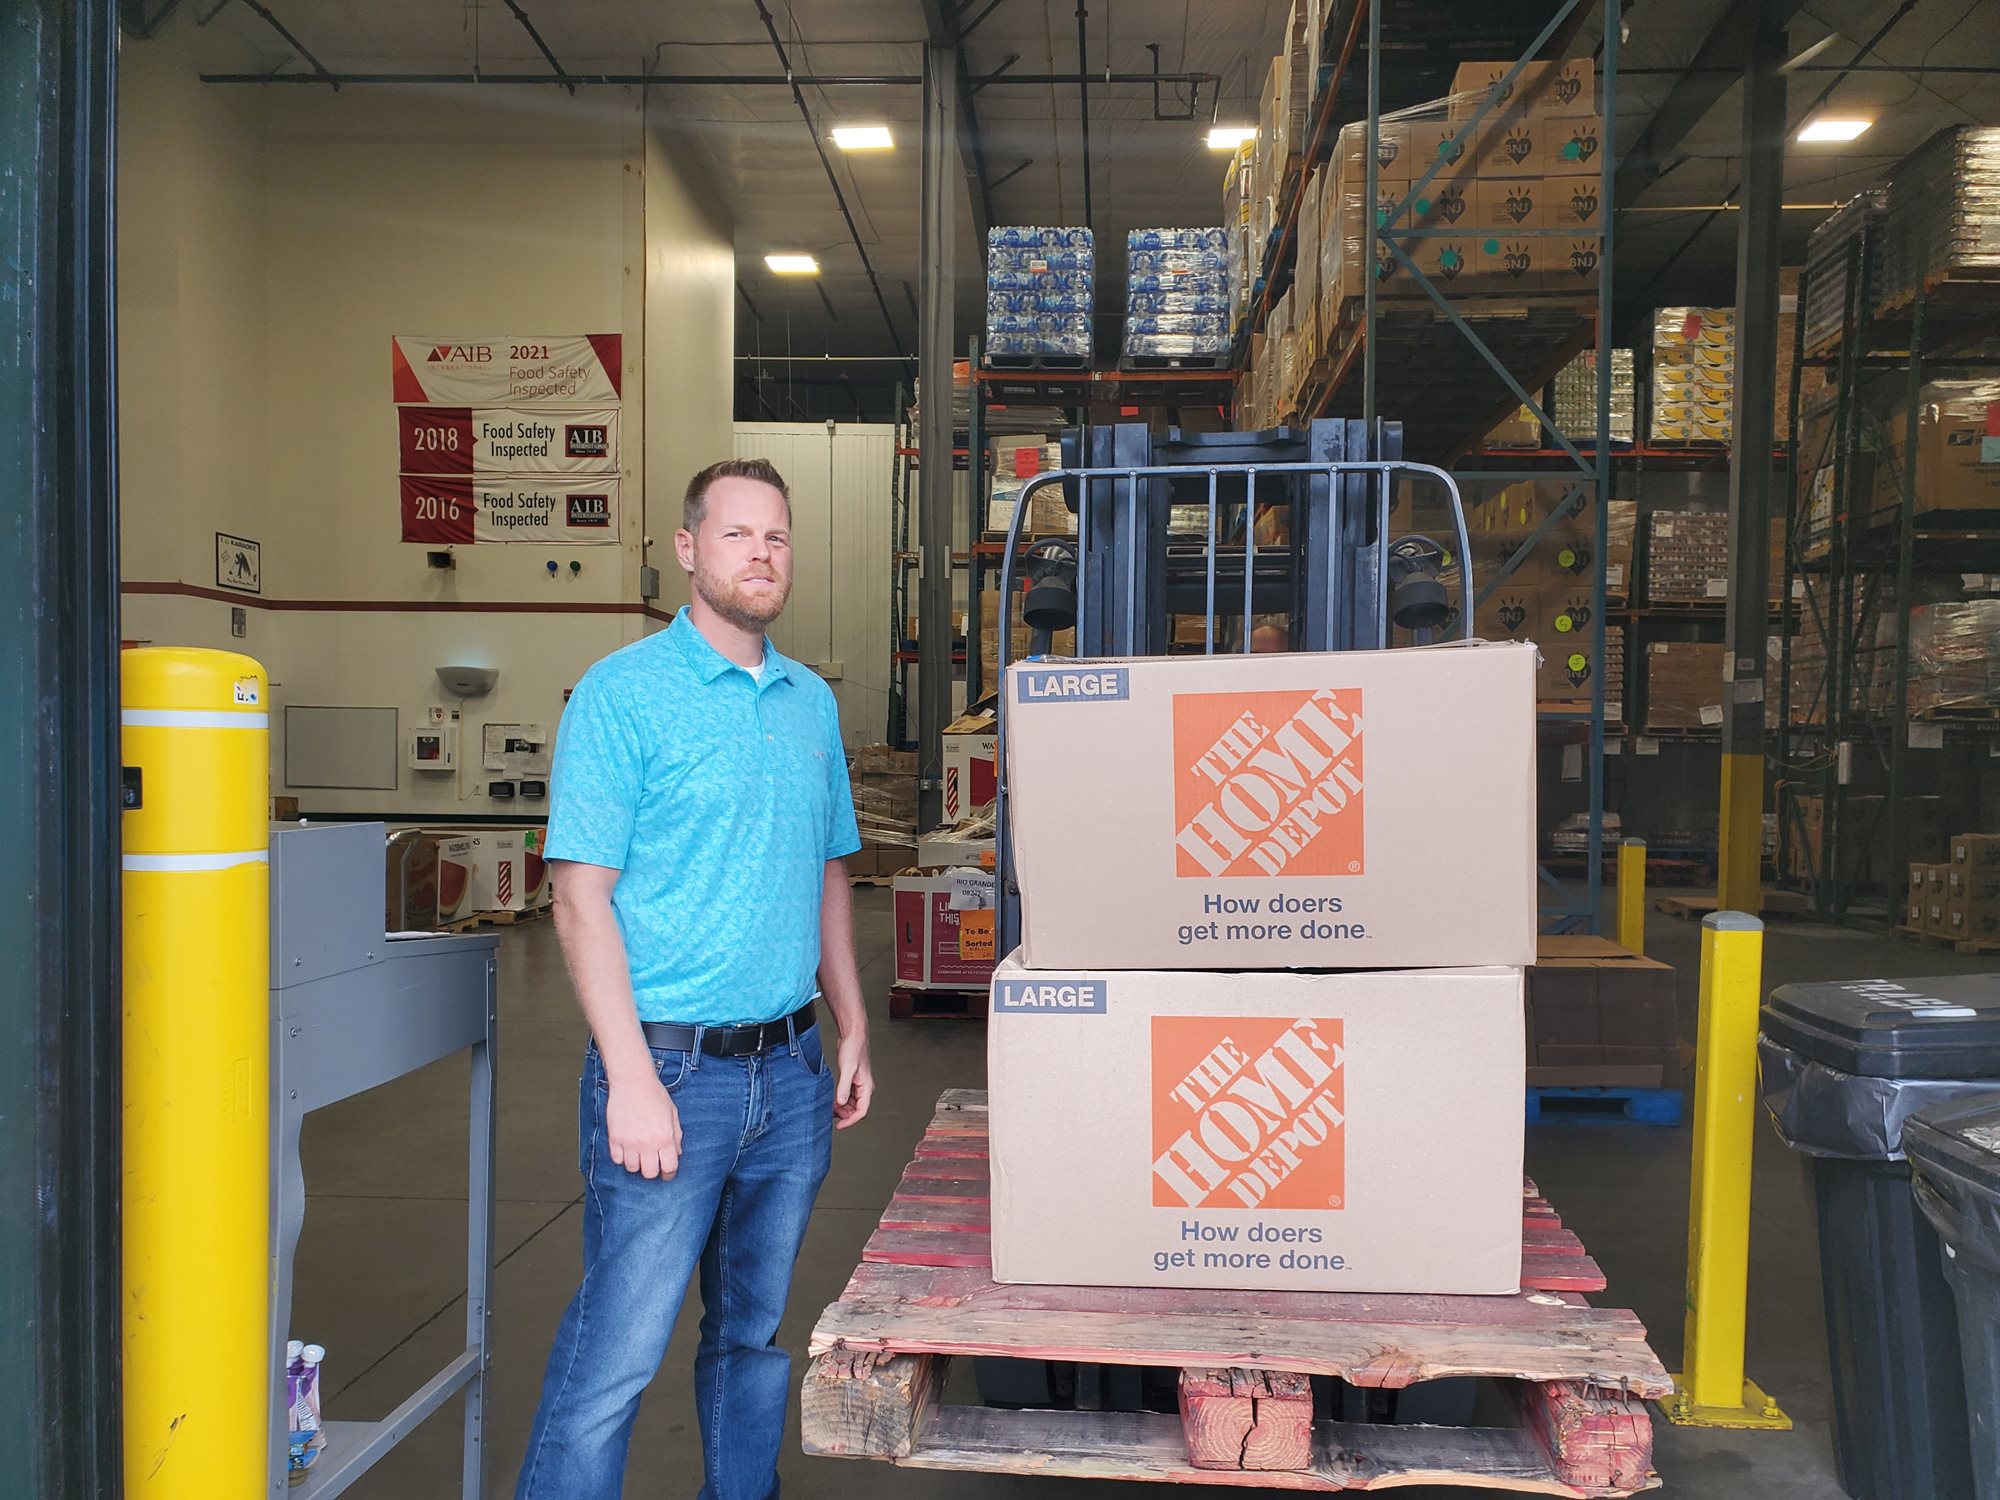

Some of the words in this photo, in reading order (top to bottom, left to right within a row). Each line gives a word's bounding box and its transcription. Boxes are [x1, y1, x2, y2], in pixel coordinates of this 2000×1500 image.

[450, 346, 493, 363] AIB
[509, 345, 550, 360] 2021
[509, 366, 544, 380] Food
[548, 366, 591, 382] Safety
[509, 382, 576, 397] Inspected
[414, 427, 459, 451] 2018
[483, 423, 513, 439] Food
[517, 423, 556, 443] Safety
[570, 429, 603, 444] AIB
[491, 442, 548, 460] Inspected
[415, 496, 460, 520] 2016
[483, 493, 514, 508] Food
[518, 492, 556, 512] Safety
[571, 499, 604, 513] AIB
[491, 511, 549, 529] Inspected
[1027, 673, 1118, 698] LARGE
[1190, 710, 1270, 787] THE
[1175, 687, 1364, 878] HOME
[1247, 756, 1365, 878] DEPOT
[1203, 894, 1260, 914] How
[1268, 893, 1343, 915] doers
[1177, 922, 1218, 944] get
[1225, 922, 1292, 941] more
[1003, 985, 1095, 1008] LARGE
[1169, 1036, 1251, 1114] THE
[1152, 1017, 1345, 1209] HOME
[1226, 1088, 1345, 1210] DEPOT
[1180, 1221, 1239, 1242] How
[1247, 1221, 1323, 1243] doers
[1153, 1250, 1196, 1272] get
[1203, 1252, 1271, 1270] more
